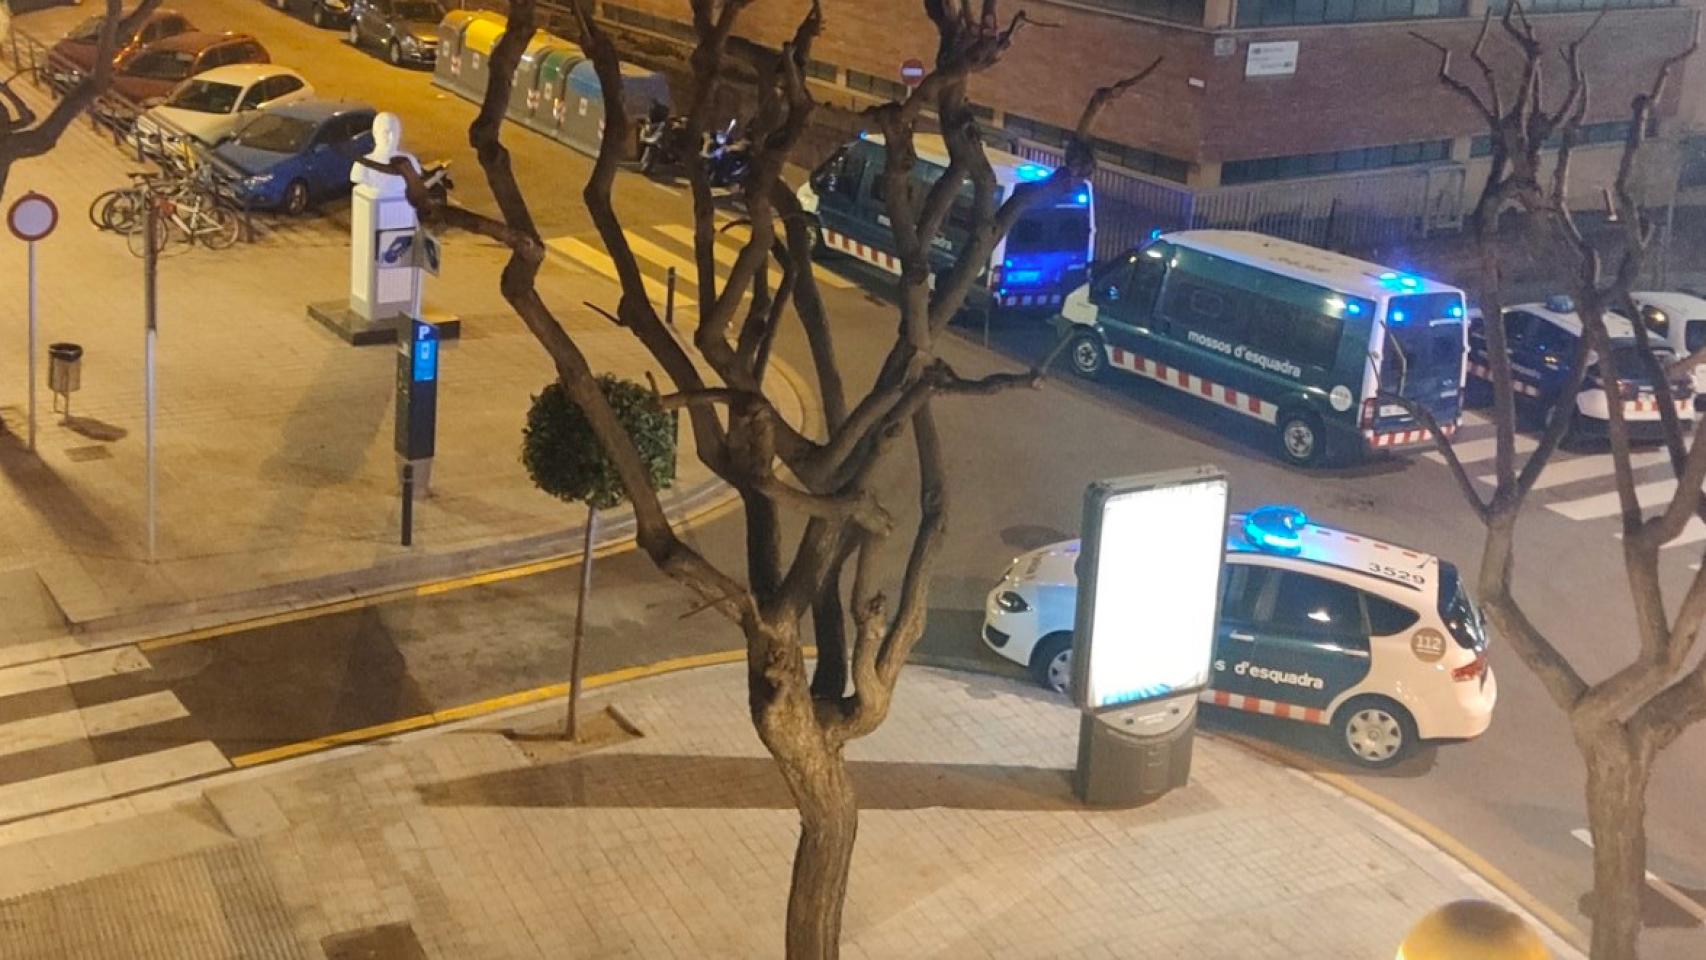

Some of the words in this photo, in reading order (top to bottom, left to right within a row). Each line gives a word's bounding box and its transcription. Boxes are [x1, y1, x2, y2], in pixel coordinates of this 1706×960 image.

[418, 325, 430, 340] P
[1188, 331, 1232, 354] mossos
[1234, 344, 1301, 377] d'esquadra
[1369, 562, 1425, 585] 3529
[1416, 635, 1442, 650] 112
[1234, 661, 1324, 690] d'esquadra
